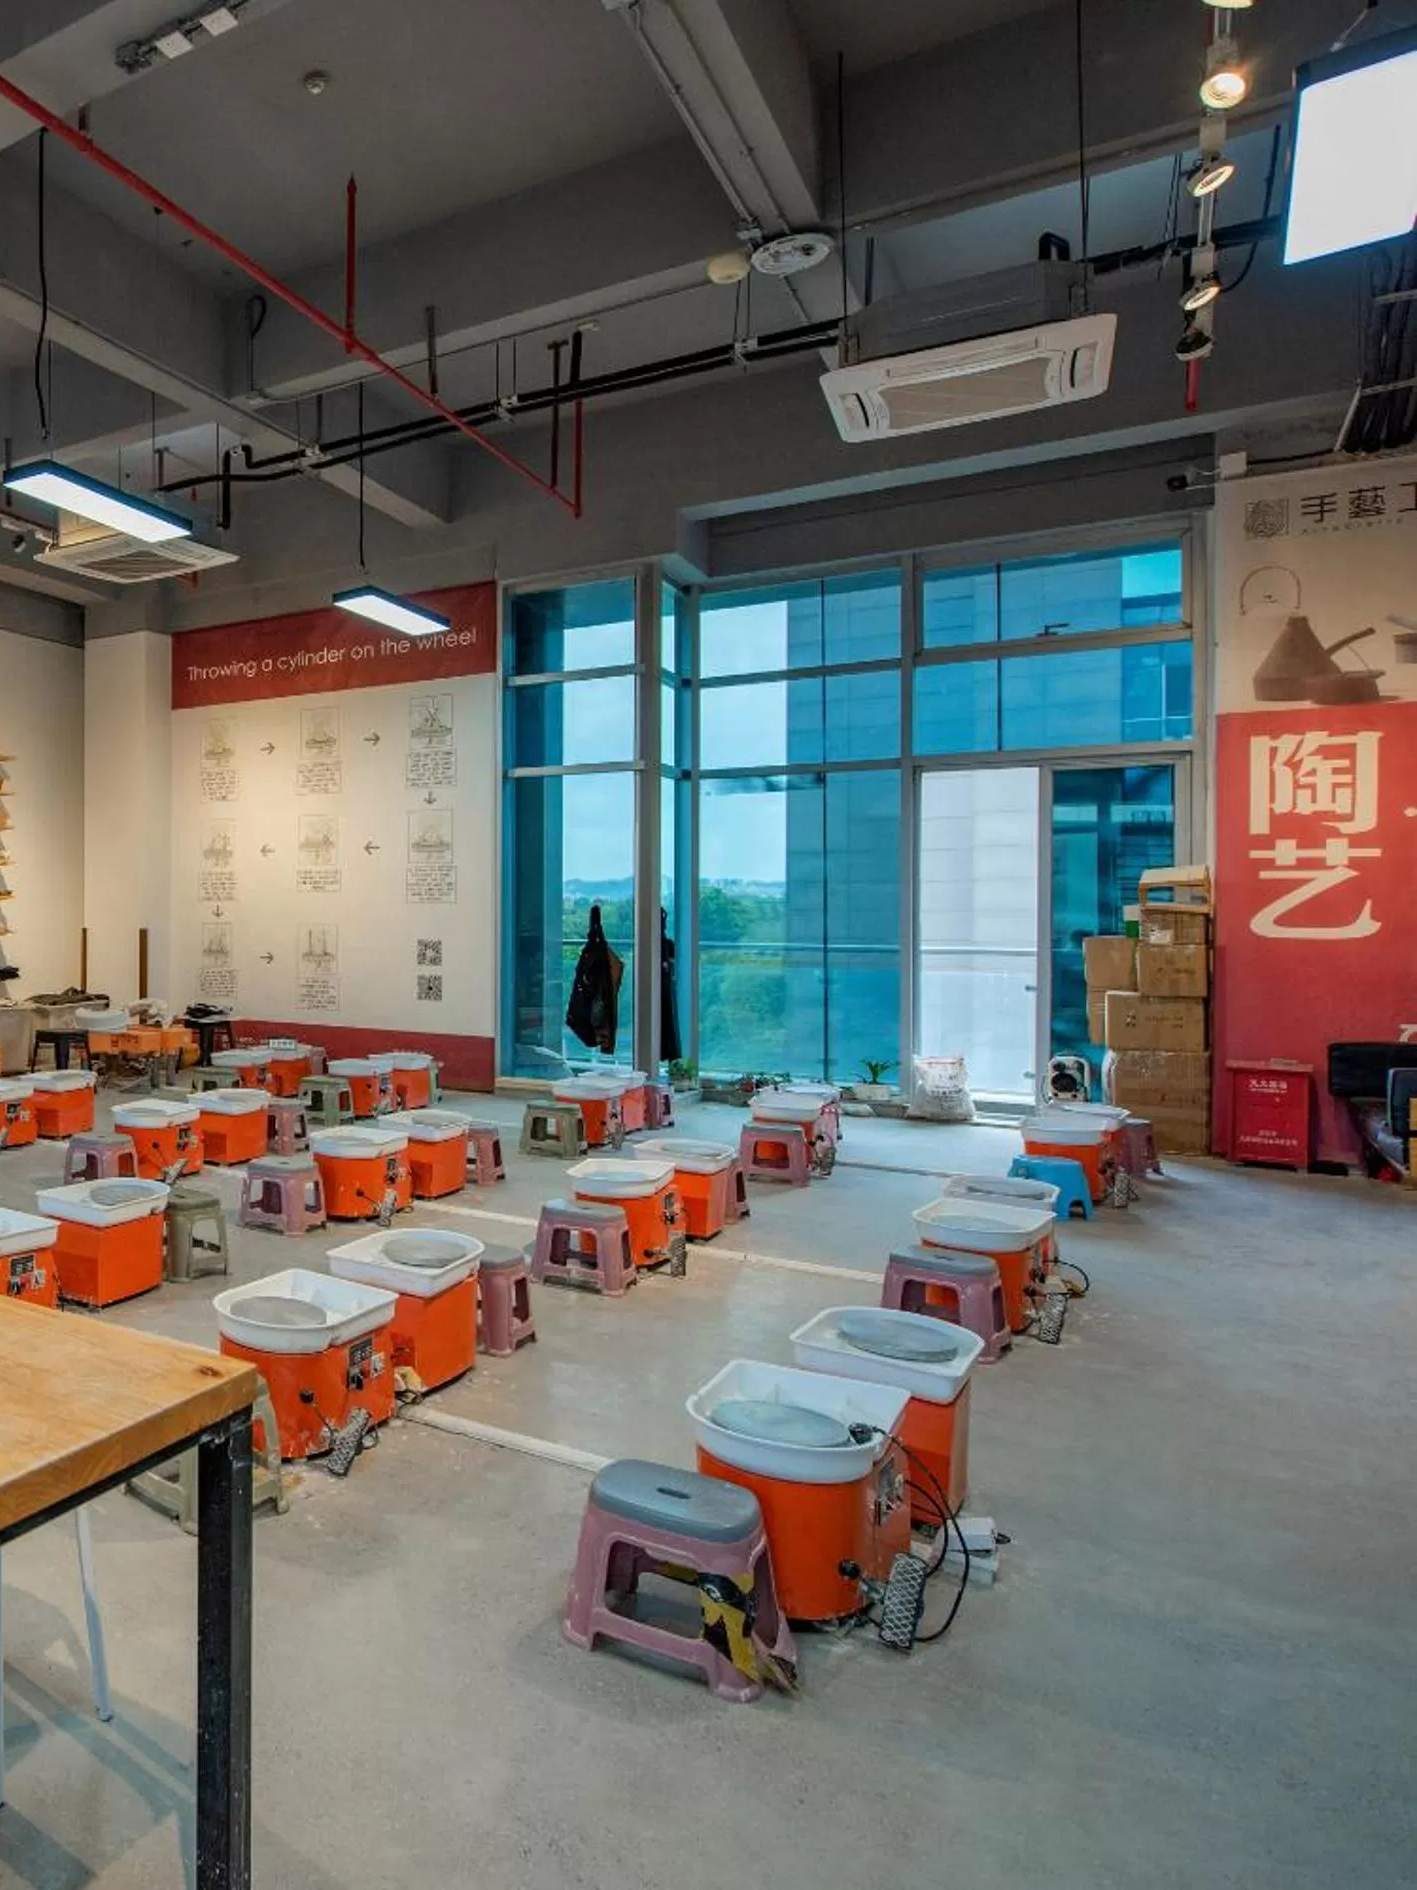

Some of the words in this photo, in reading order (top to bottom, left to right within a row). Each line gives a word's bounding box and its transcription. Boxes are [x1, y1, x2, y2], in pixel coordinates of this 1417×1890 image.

[187, 659, 256, 681] Throwing
[262, 657, 273, 672] a
[277, 647, 345, 672] cylinder
[350, 643, 374, 660] on
[380, 638, 410, 656] the
[416, 628, 477, 650] wheel
[1249, 731, 1385, 939] 陶艺
